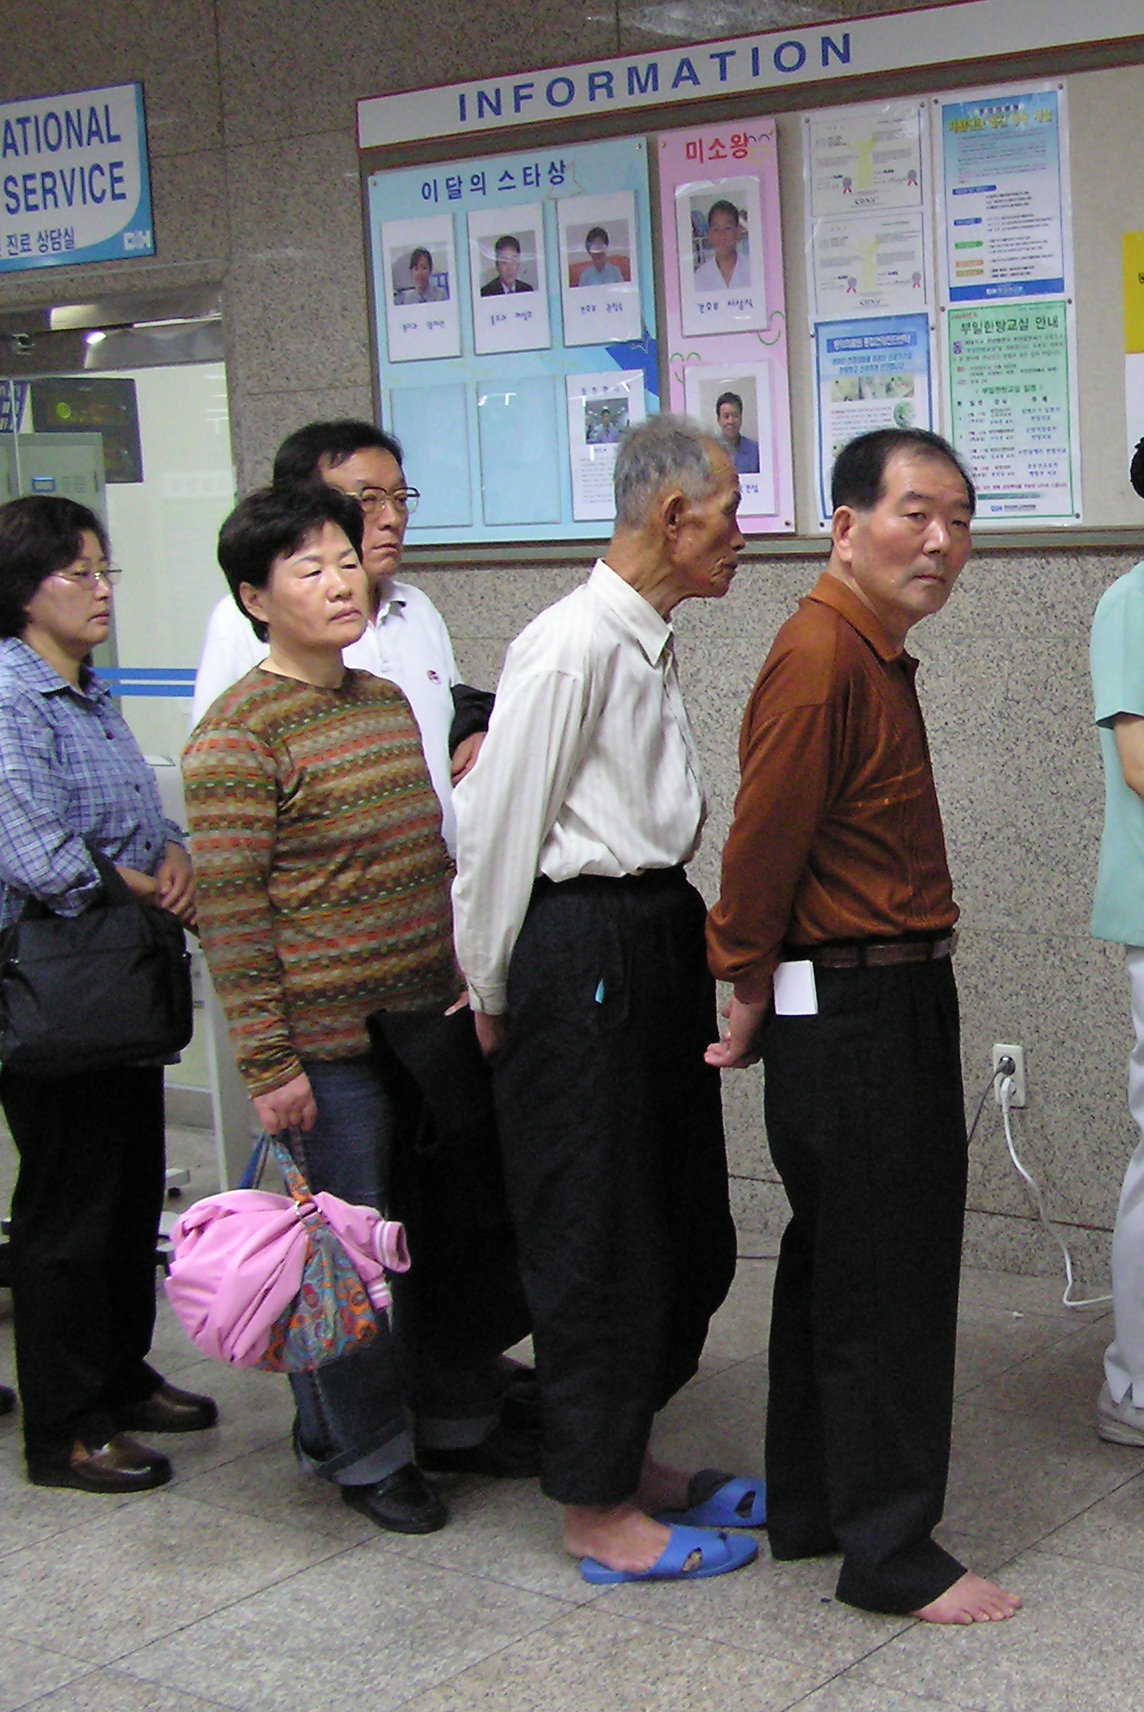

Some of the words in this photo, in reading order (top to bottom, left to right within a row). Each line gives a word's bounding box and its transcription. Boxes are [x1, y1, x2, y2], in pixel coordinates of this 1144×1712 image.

[458, 33, 853, 122] INFORMATION
[2, 104, 122, 159] ATIONAL
[686, 132, 750, 165] 미소왕
[3, 160, 127, 215] SERVICE
[421, 171, 487, 203] 이달의
[497, 159, 567, 191] 스타상
[6, 232, 32, 257] 진료
[38, 225, 76, 254] 상담실
[1034, 314, 1059, 330] 안내
